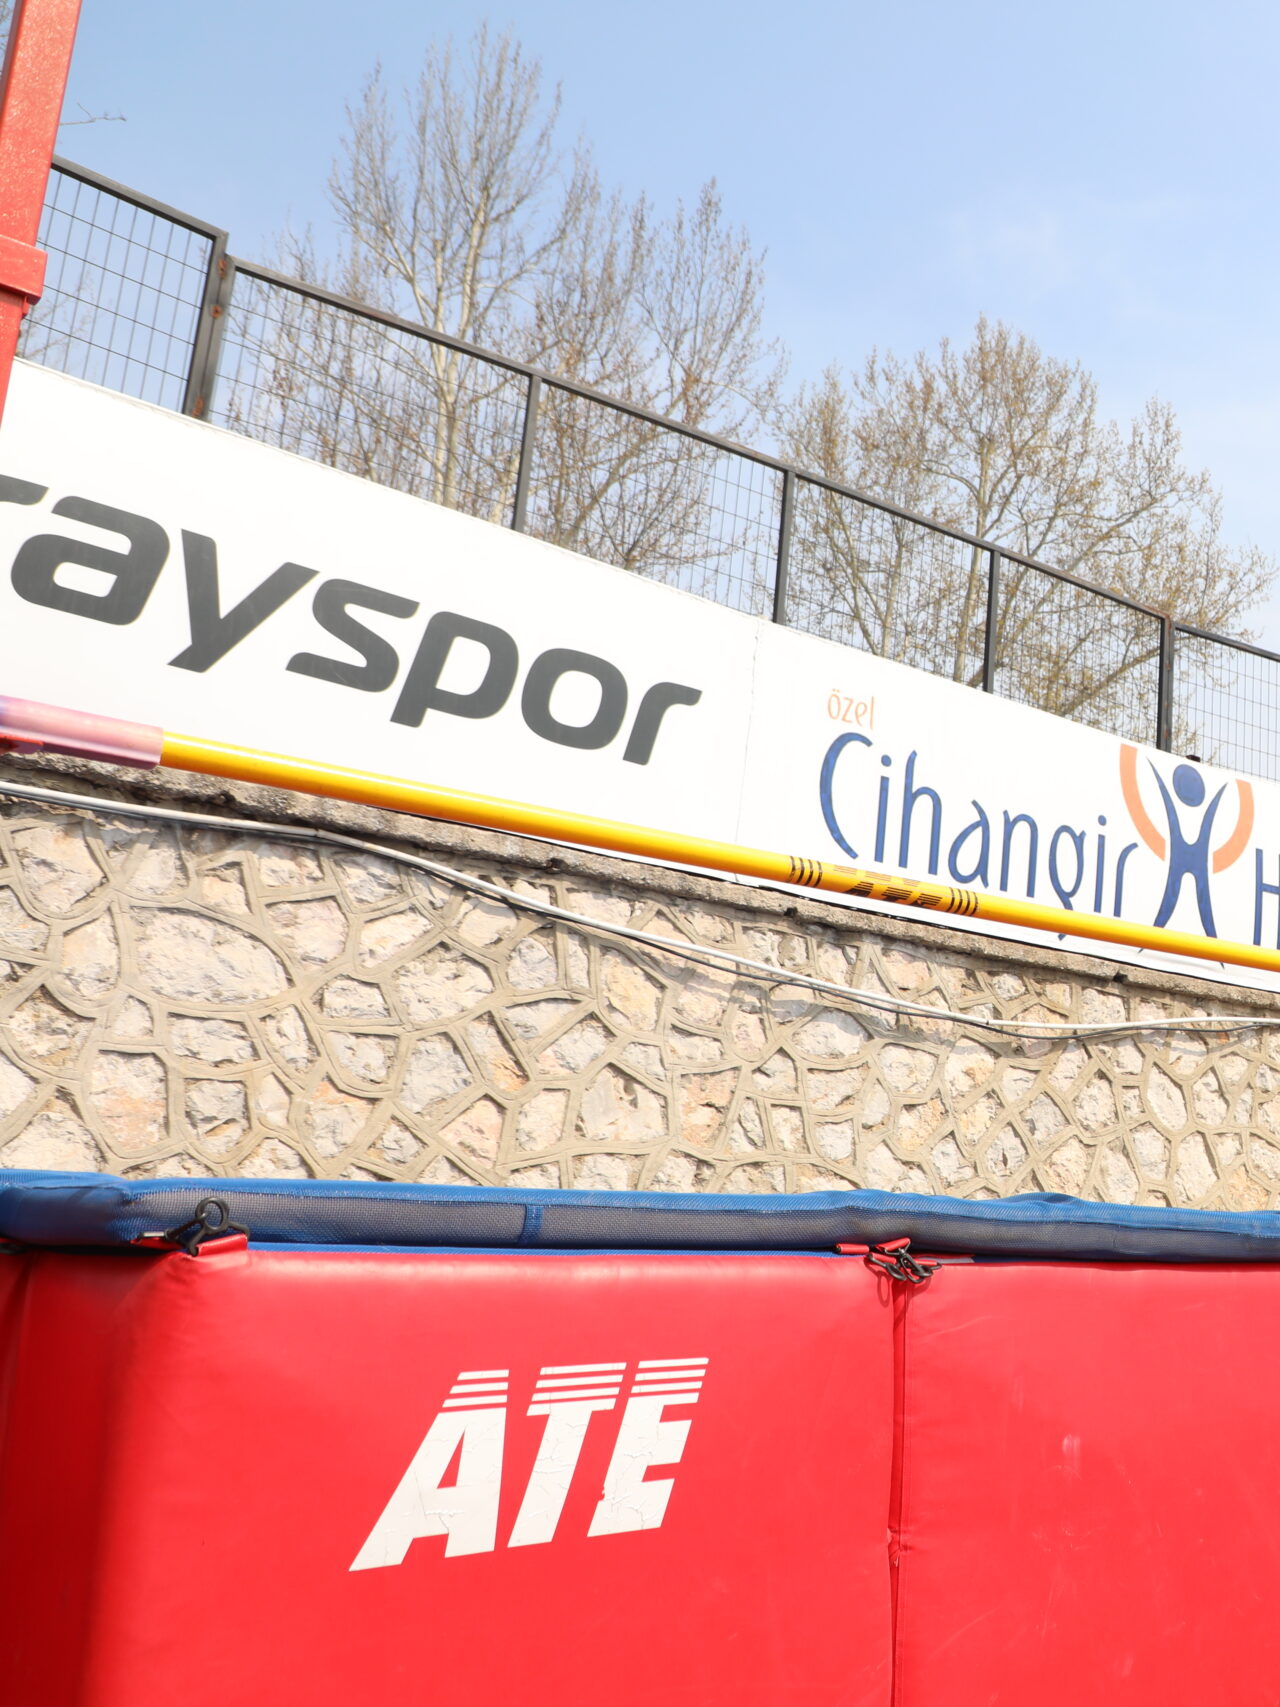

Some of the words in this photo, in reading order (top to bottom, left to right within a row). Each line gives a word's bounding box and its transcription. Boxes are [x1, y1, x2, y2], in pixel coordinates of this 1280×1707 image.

[0, 474, 702, 766] ayspor
[827, 688, 876, 730] özel
[819, 731, 1139, 940] Cihangir
[348, 1356, 710, 1573] ATE
